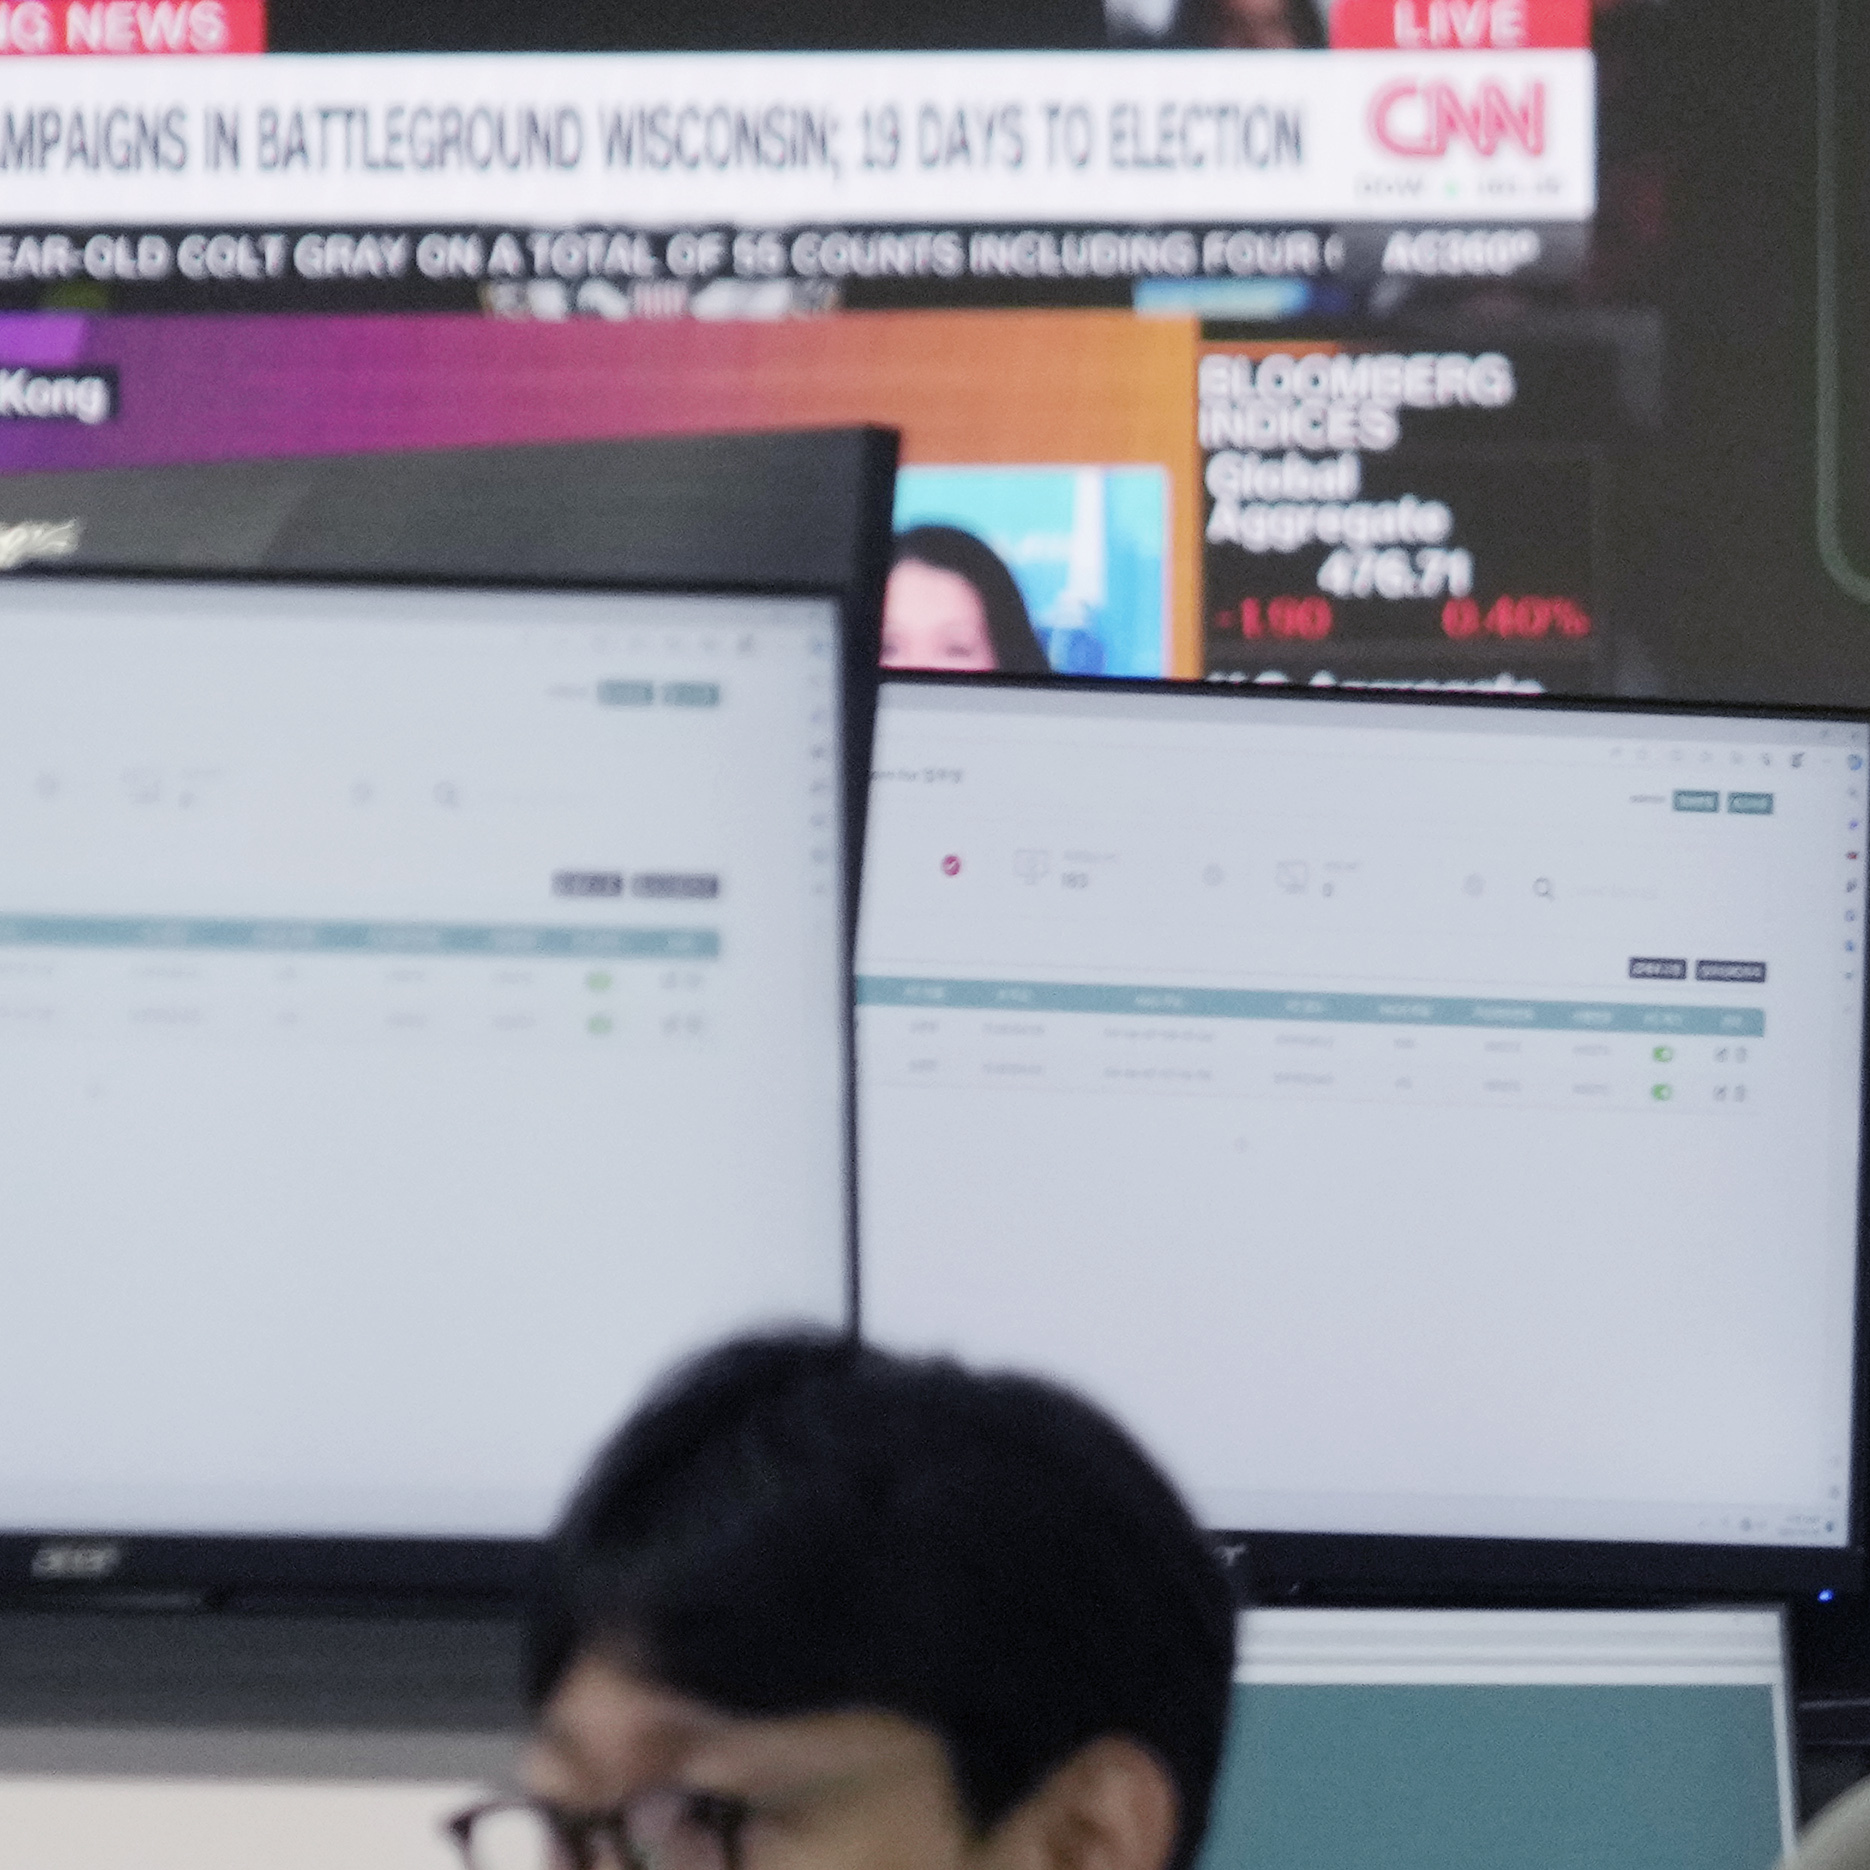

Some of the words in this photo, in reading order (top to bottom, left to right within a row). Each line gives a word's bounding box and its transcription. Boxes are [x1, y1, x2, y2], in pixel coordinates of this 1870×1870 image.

[0, 2, 52, 52] G
[66, 1, 228, 52] NEWS
[1393, 0, 1525, 48] LIVE
[0, 104, 188, 172] MPAIGNS
[204, 105, 240, 171] IN
[258, 104, 584, 172] BATTLEGROUND
[602, 104, 842, 180] WISCONSIN;
[862, 104, 899, 169] 19
[918, 103, 1024, 170] DAYS
[1041, 103, 1092, 169] TO
[1109, 102, 1304, 170] ELECTION
[1365, 74, 1547, 160] CNN
[176, 232, 291, 281] COLT
[293, 232, 411, 280] GRAY
[415, 231, 484, 280] ON
[486, 231, 527, 280] A
[528, 231, 661, 279] TOTAL
[665, 231, 727, 278] OF
[789, 230, 965, 278] COUNTS
[968, 230, 1200, 278] INCLUDING
[1201, 230, 1321, 278] FOUR
[1198, 352, 1516, 407] BLOOMBERG
[1198, 403, 1401, 451] INDICES
[1205, 451, 1361, 502] Global
[1206, 495, 1454, 554] Aggregate
